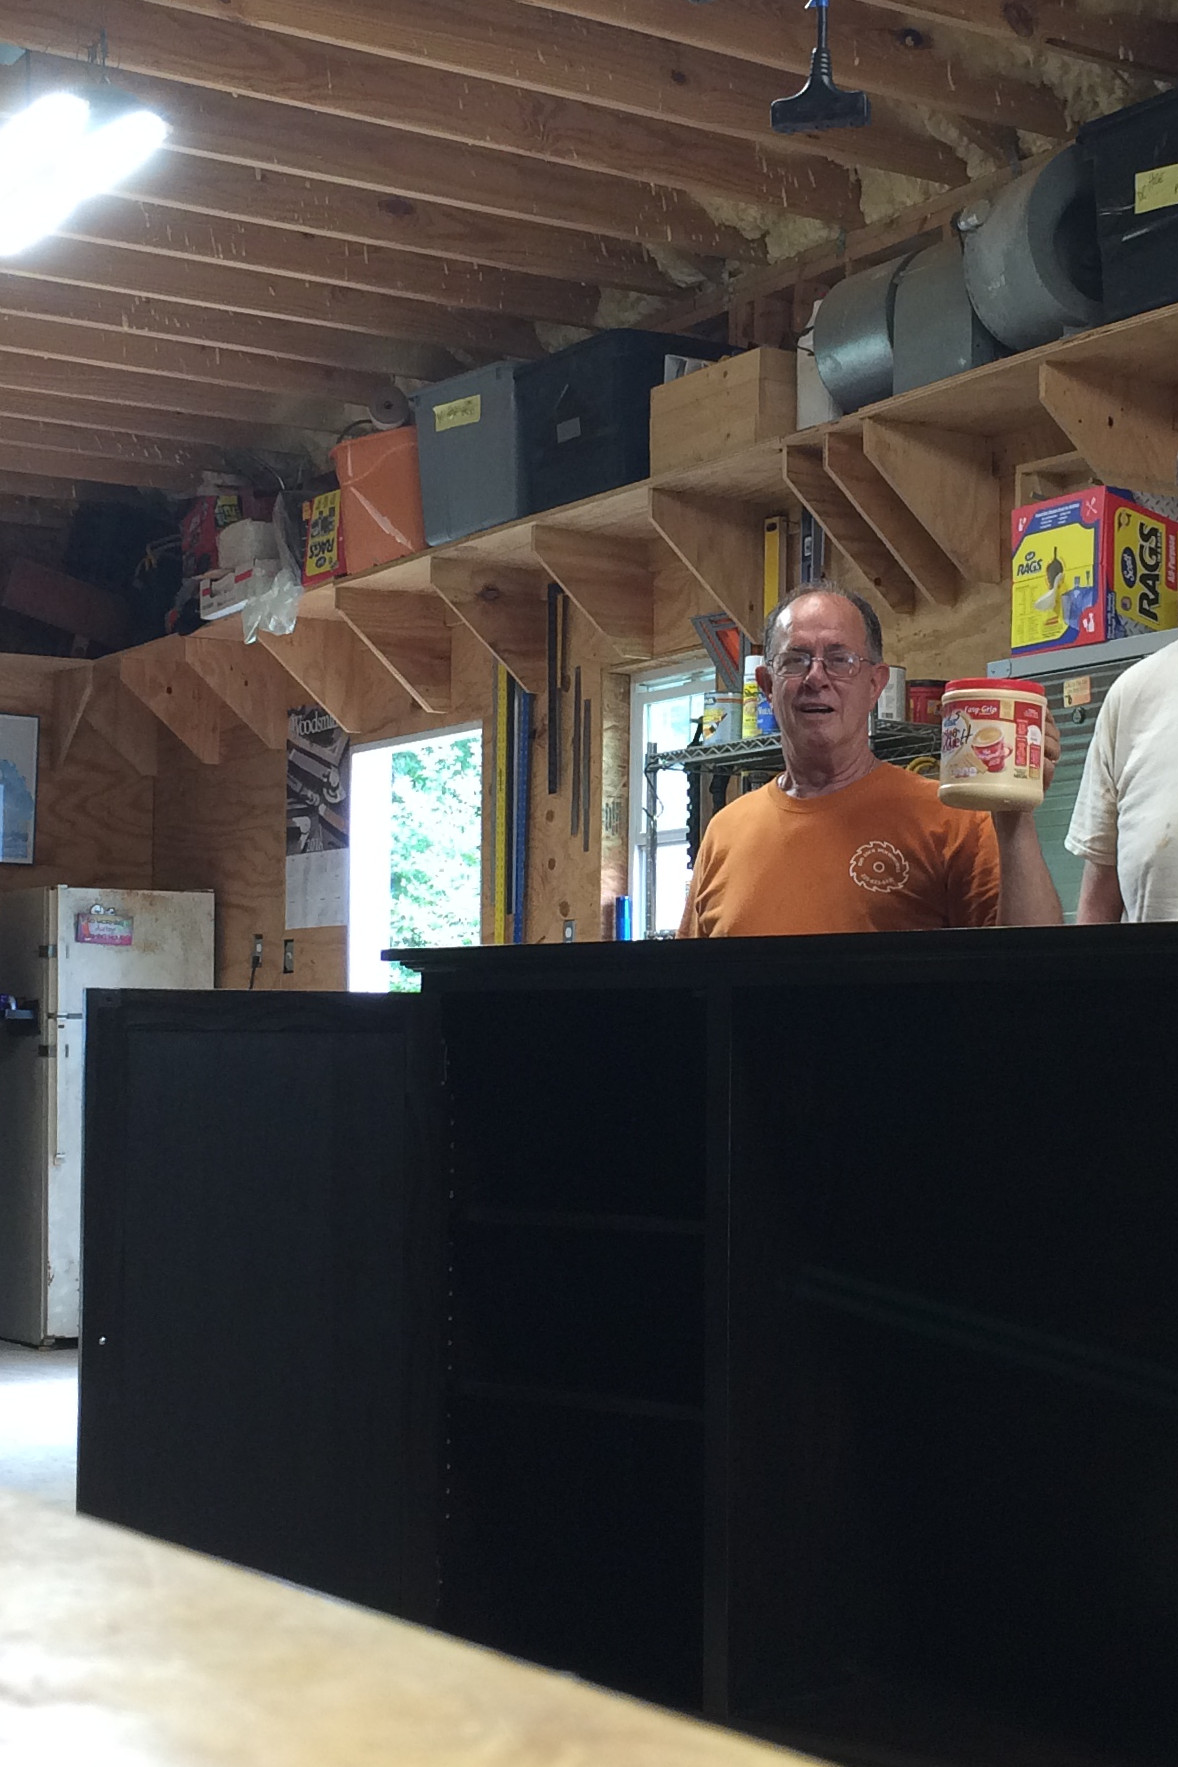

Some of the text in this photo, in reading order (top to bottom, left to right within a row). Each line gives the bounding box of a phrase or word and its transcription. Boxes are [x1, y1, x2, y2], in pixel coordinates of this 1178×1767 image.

[308, 539, 334, 559] RAGS
[1167, 534, 1177, 583] All-Purpose
[1017, 559, 1043, 576] RAGS
[1125, 553, 1136, 582] Scott
[1138, 522, 1161, 623] RAGS
